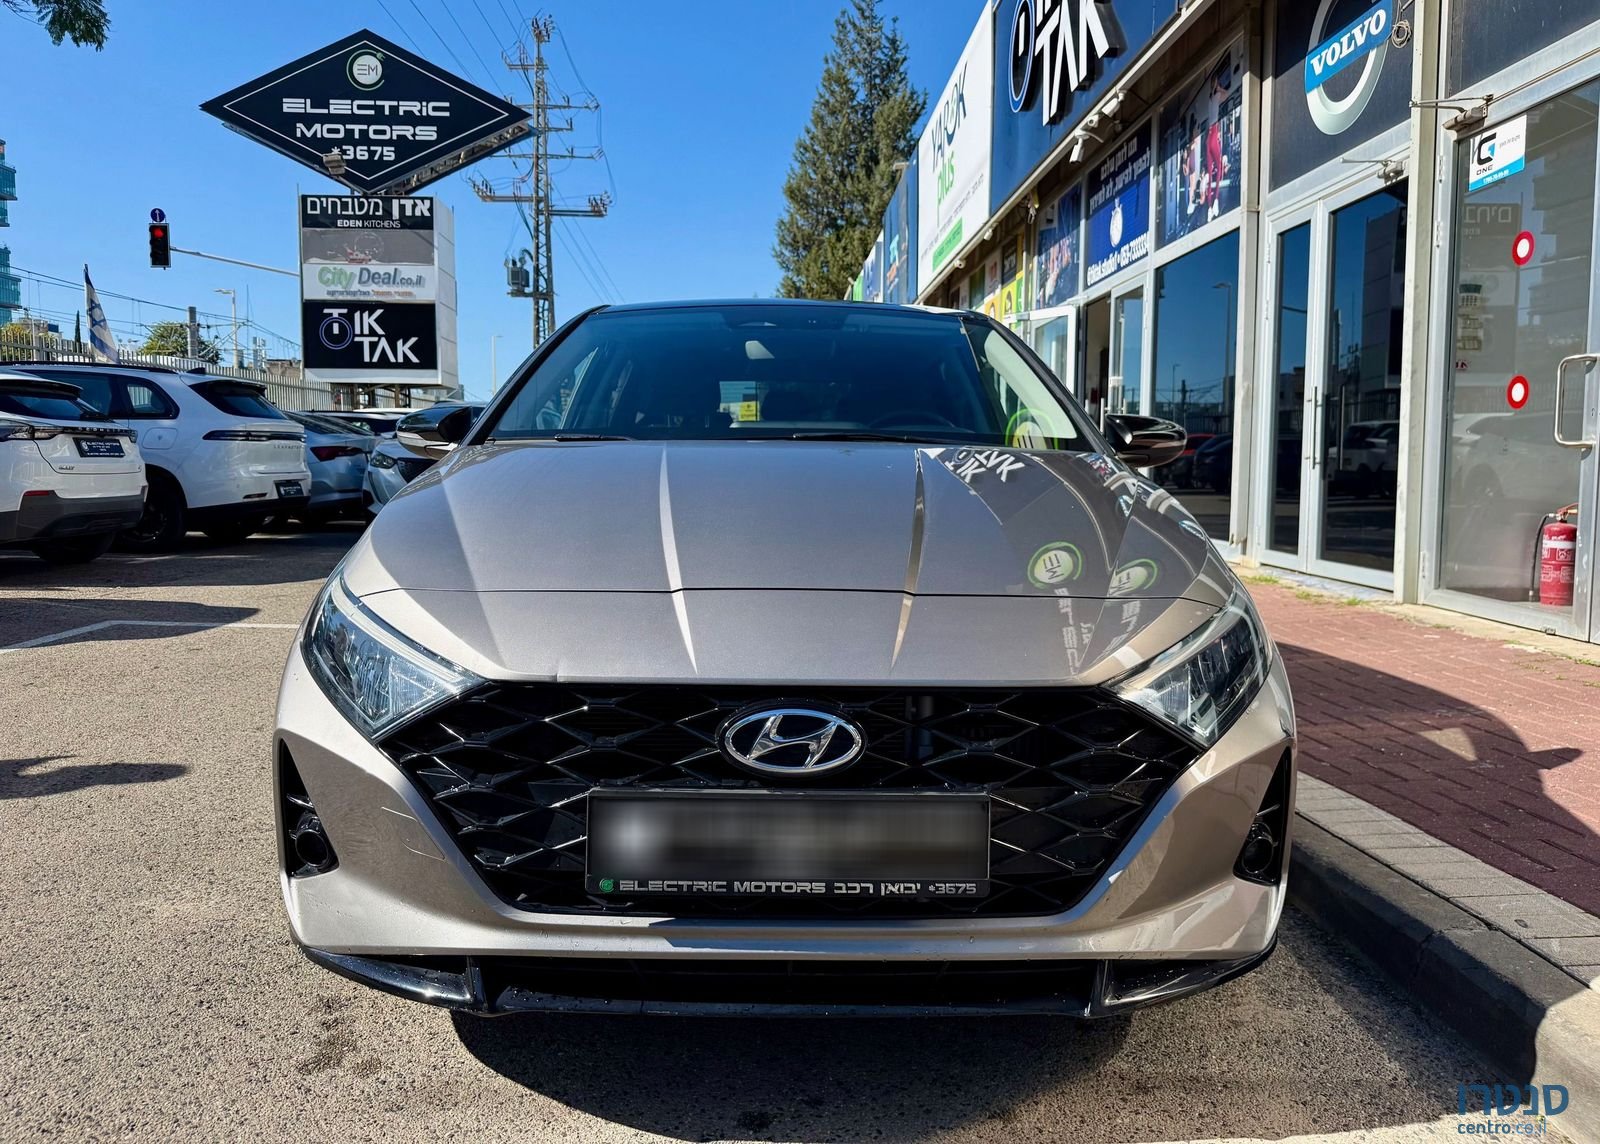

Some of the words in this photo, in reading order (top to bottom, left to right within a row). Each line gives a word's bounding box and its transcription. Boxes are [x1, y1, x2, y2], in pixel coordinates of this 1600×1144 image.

[1310, 9, 1387, 77] VOLVO
[357, 63, 378, 76] EM
[282, 97, 450, 117] ELECTRIC
[931, 61, 968, 173] YAROK
[296, 123, 437, 140] MOTORS
[937, 151, 955, 228] plus
[307, 197, 383, 216] מטבחים
[391, 199, 431, 220] אדן
[337, 219, 363, 228] EDEN
[363, 219, 401, 228] KITCHENS
[318, 266, 354, 290] City
[322, 308, 386, 336] TIK
[353, 336, 421, 363] TAK
[619, 879, 727, 893] ELECTRIC
[733, 880, 826, 894] MOTORS
[833, 883, 874, 894] רכב
[880, 882, 921, 896] יבואן
